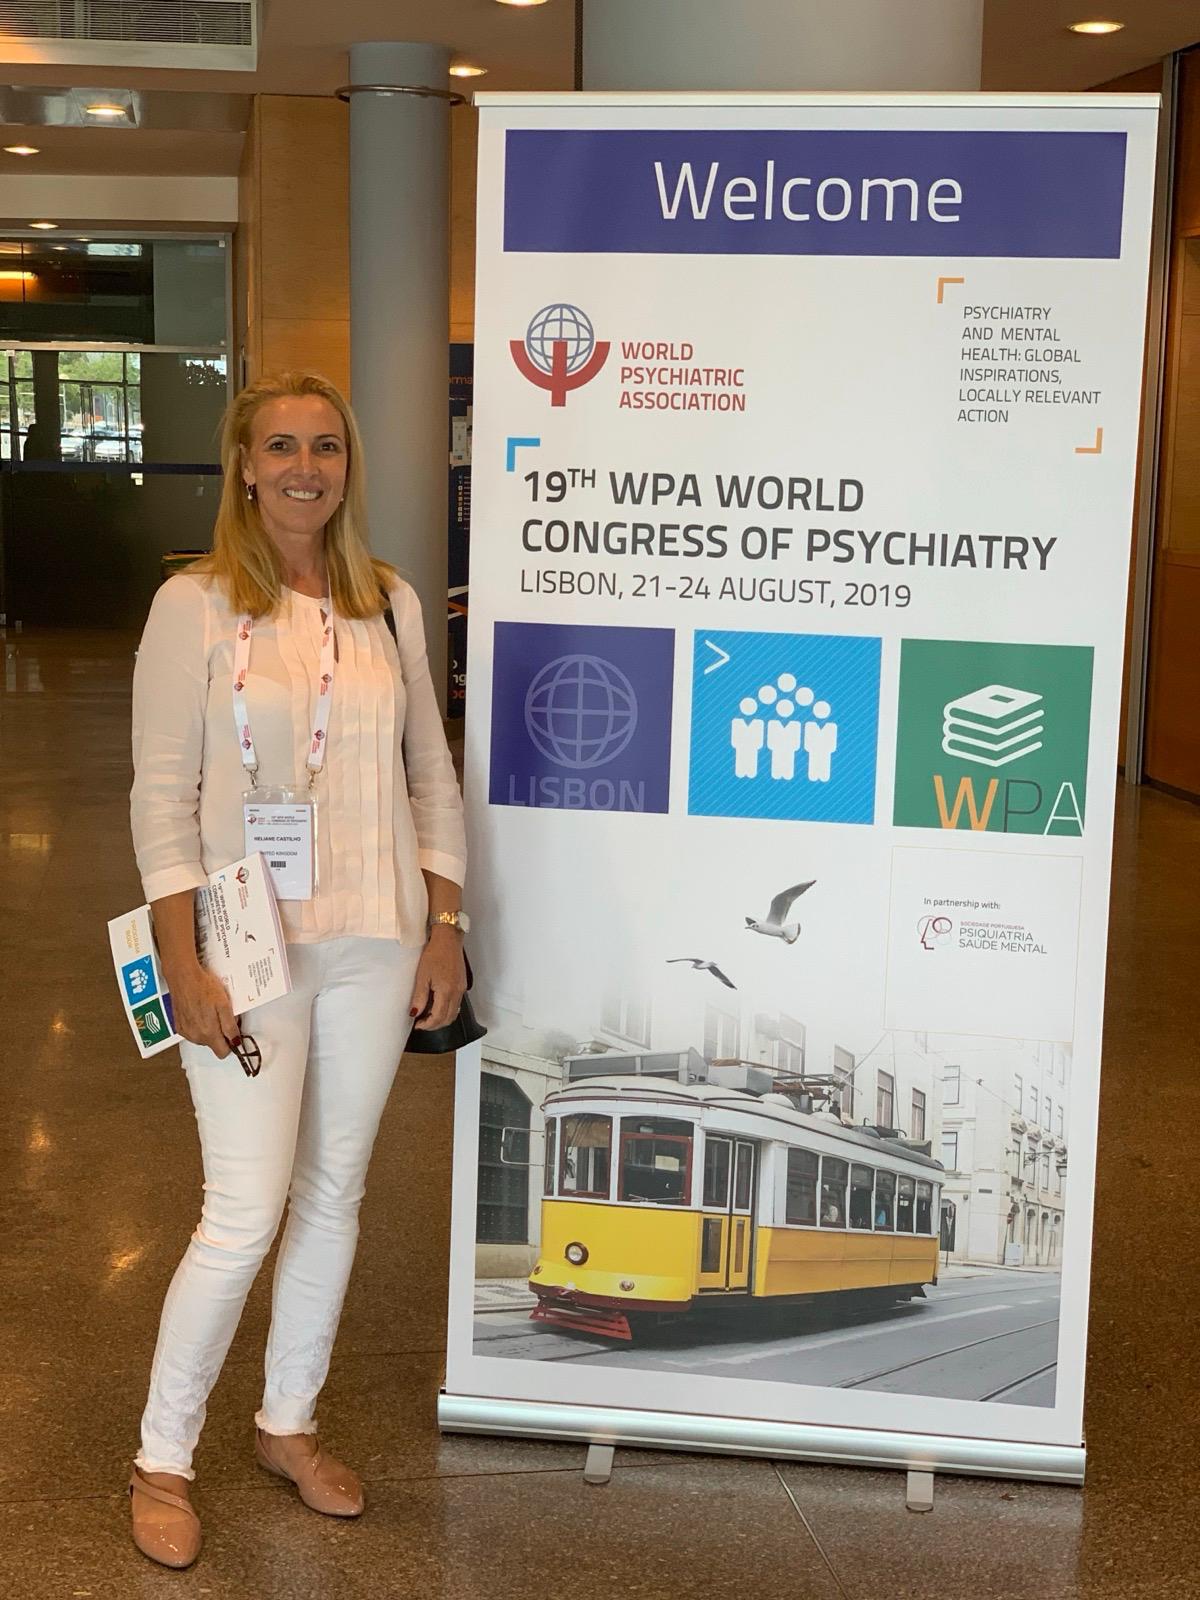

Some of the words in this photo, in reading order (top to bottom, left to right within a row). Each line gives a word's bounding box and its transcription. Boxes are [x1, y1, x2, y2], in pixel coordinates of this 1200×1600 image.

[655, 160, 962, 222] Welcome
[964, 306, 1051, 320] PSYCHIATRY
[962, 327, 993, 340] AND
[1002, 328, 1060, 341] MENTAL
[622, 342, 693, 360] WORLD
[961, 348, 1021, 362] HEALTH:
[1025, 349, 1081, 362] GLOBAL
[621, 367, 744, 386] PSYCHIATRIC
[961, 369, 1061, 384] INSPIRATIONS,
[620, 392, 745, 411] ASSOCIATION
[960, 389, 1021, 402] LOCALLY
[1026, 390, 1101, 404] RELEVANT
[958, 409, 1008, 422] ACTION
[525, 469, 595, 502] 19TH
[609, 472, 701, 506] WPA
[716, 475, 863, 512] WORLD
[523, 519, 727, 558] CONGRESS
[741, 527, 793, 560] OF
[807, 529, 1057, 570] PSYCHIATRY
[521, 570, 622, 599] LISBON,
[632, 575, 710, 599] 21-24
[719, 577, 834, 608] AUGUST,
[845, 583, 910, 607] 2019
[508, 774, 645, 811] LISBON
[934, 775, 1085, 836] WPA
[933, 899, 979, 909] partnership
[959, 928, 1033, 941] PSIQUIATRIA
[959, 938, 997, 950] SAÚDE
[1001, 942, 1047, 954] MENTAL
